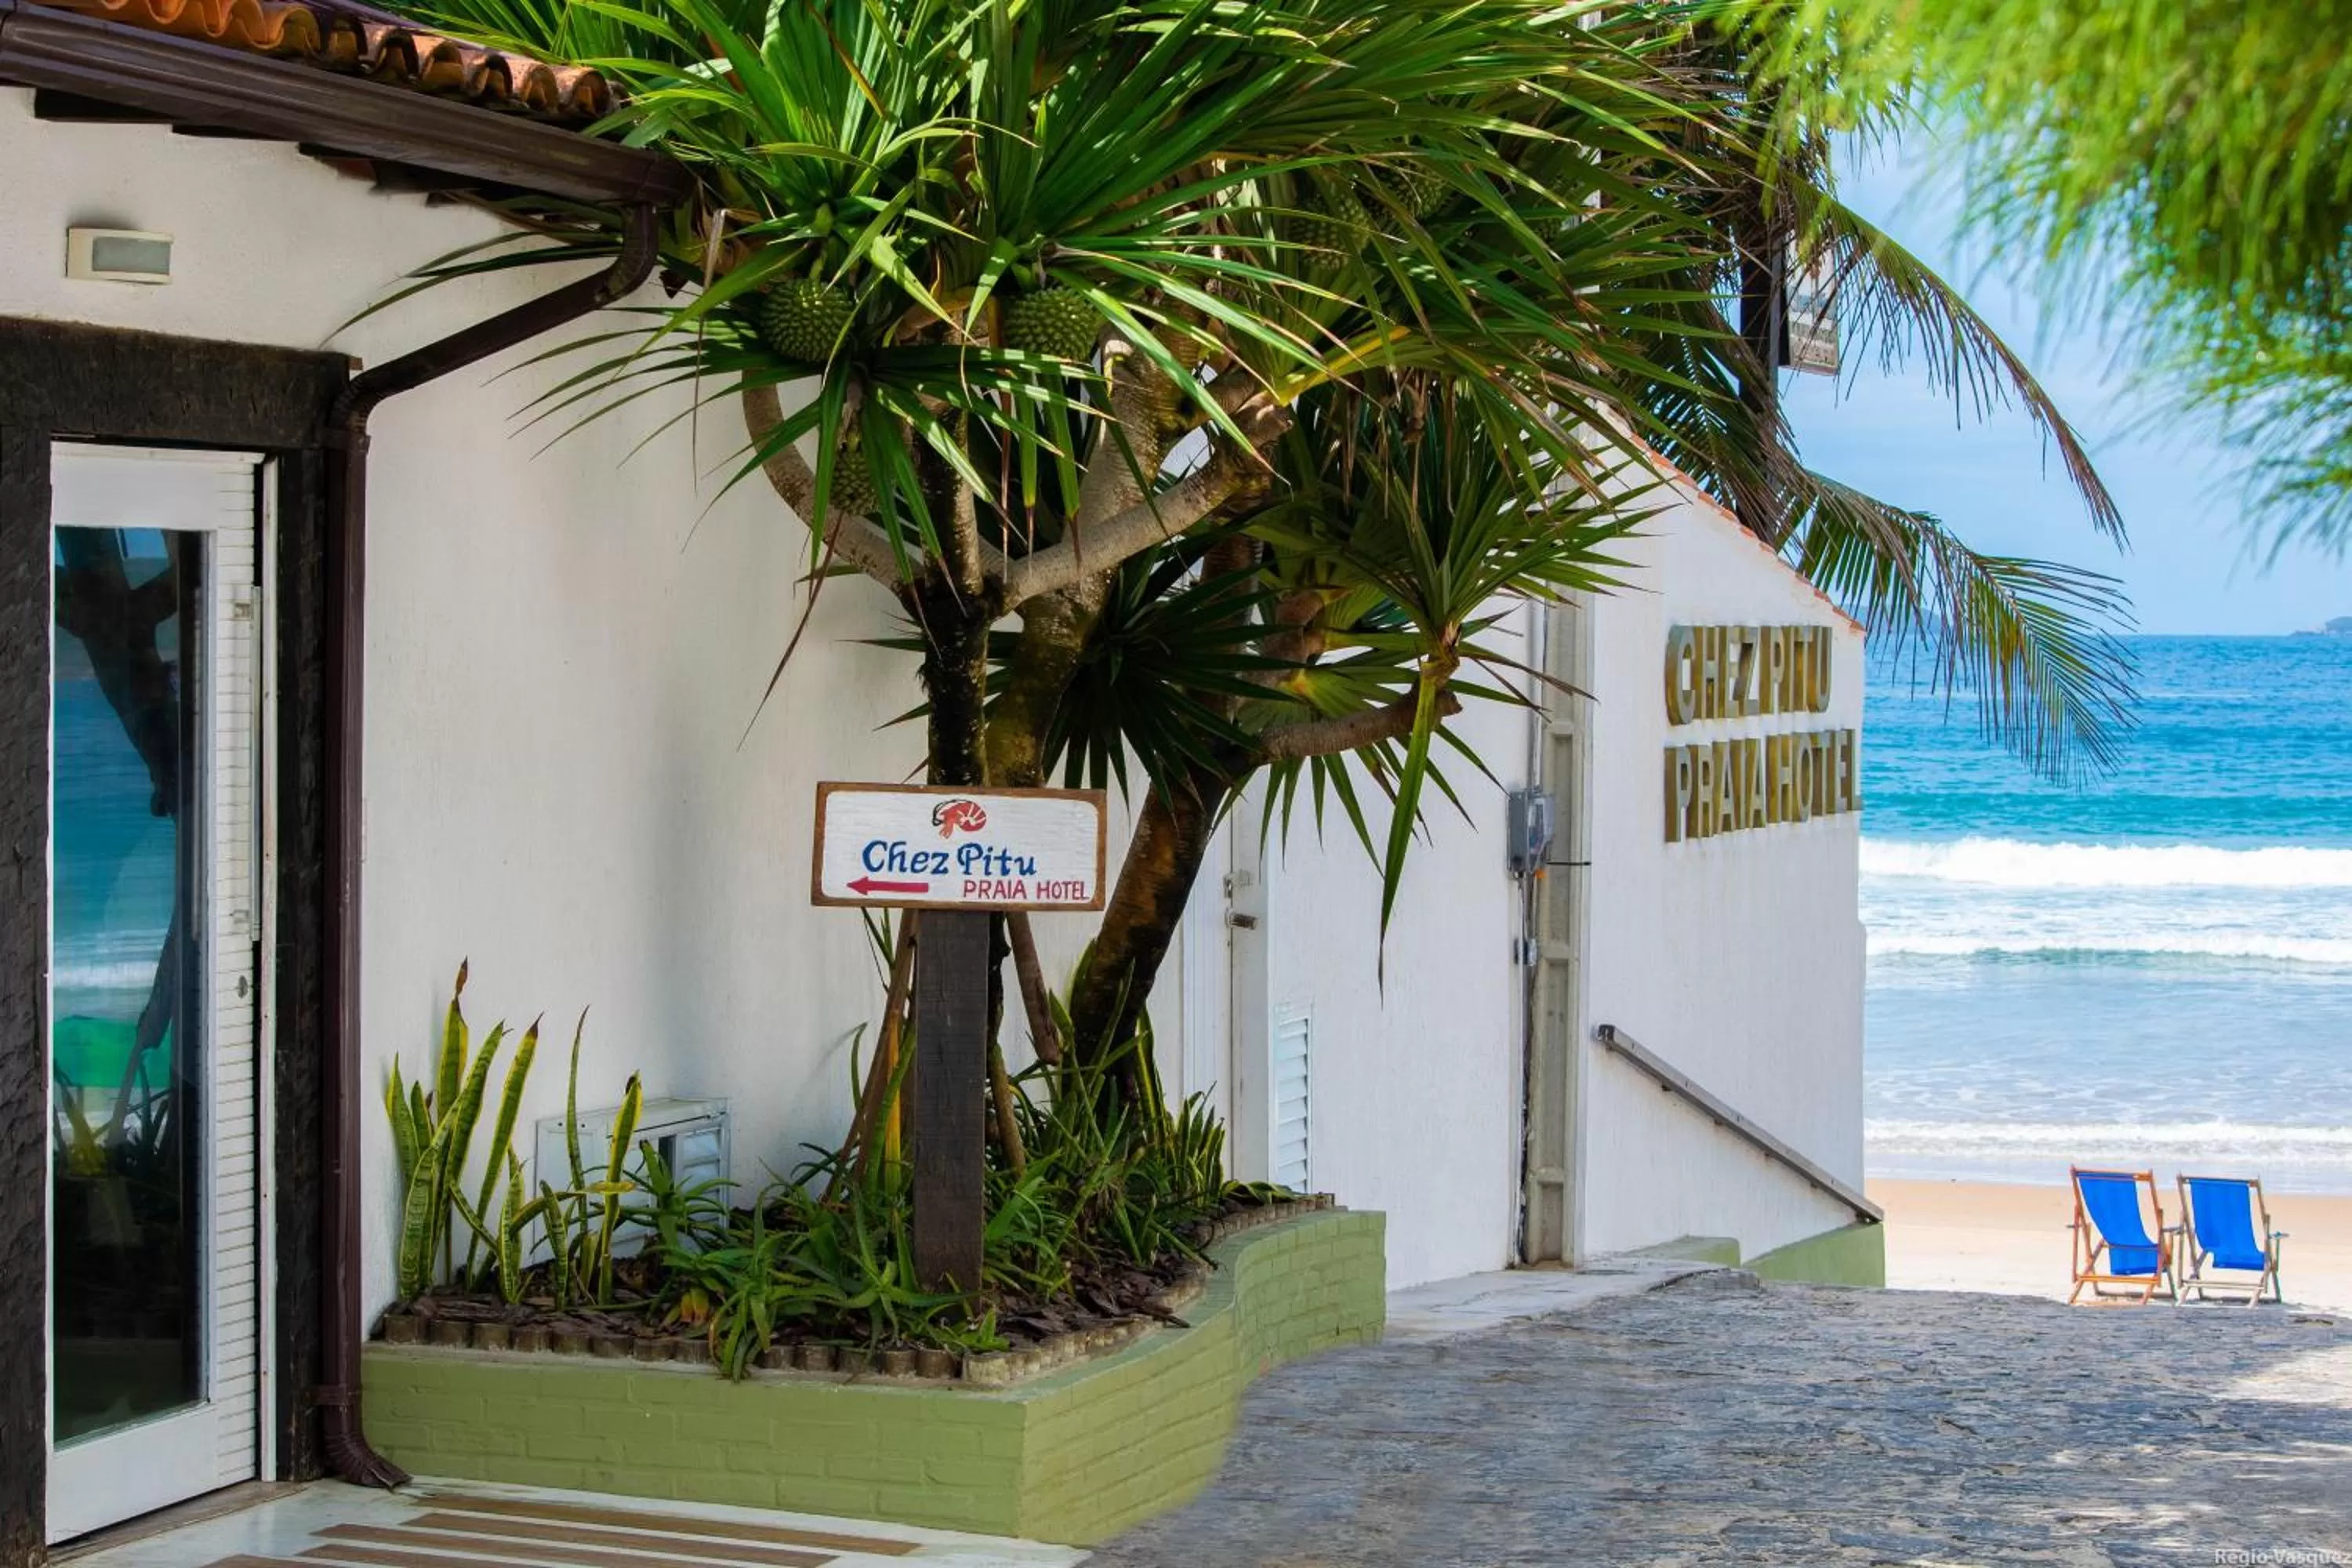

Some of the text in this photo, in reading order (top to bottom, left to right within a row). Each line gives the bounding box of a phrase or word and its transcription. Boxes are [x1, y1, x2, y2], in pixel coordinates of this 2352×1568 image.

[1664, 625, 1833, 725] CHEZ PITU
[1664, 728, 1864, 842] PRAIA HOTEL
[862, 840, 1037, 876] Chez Pitu
[963, 879, 1090, 900] PRAIA HOTEL
